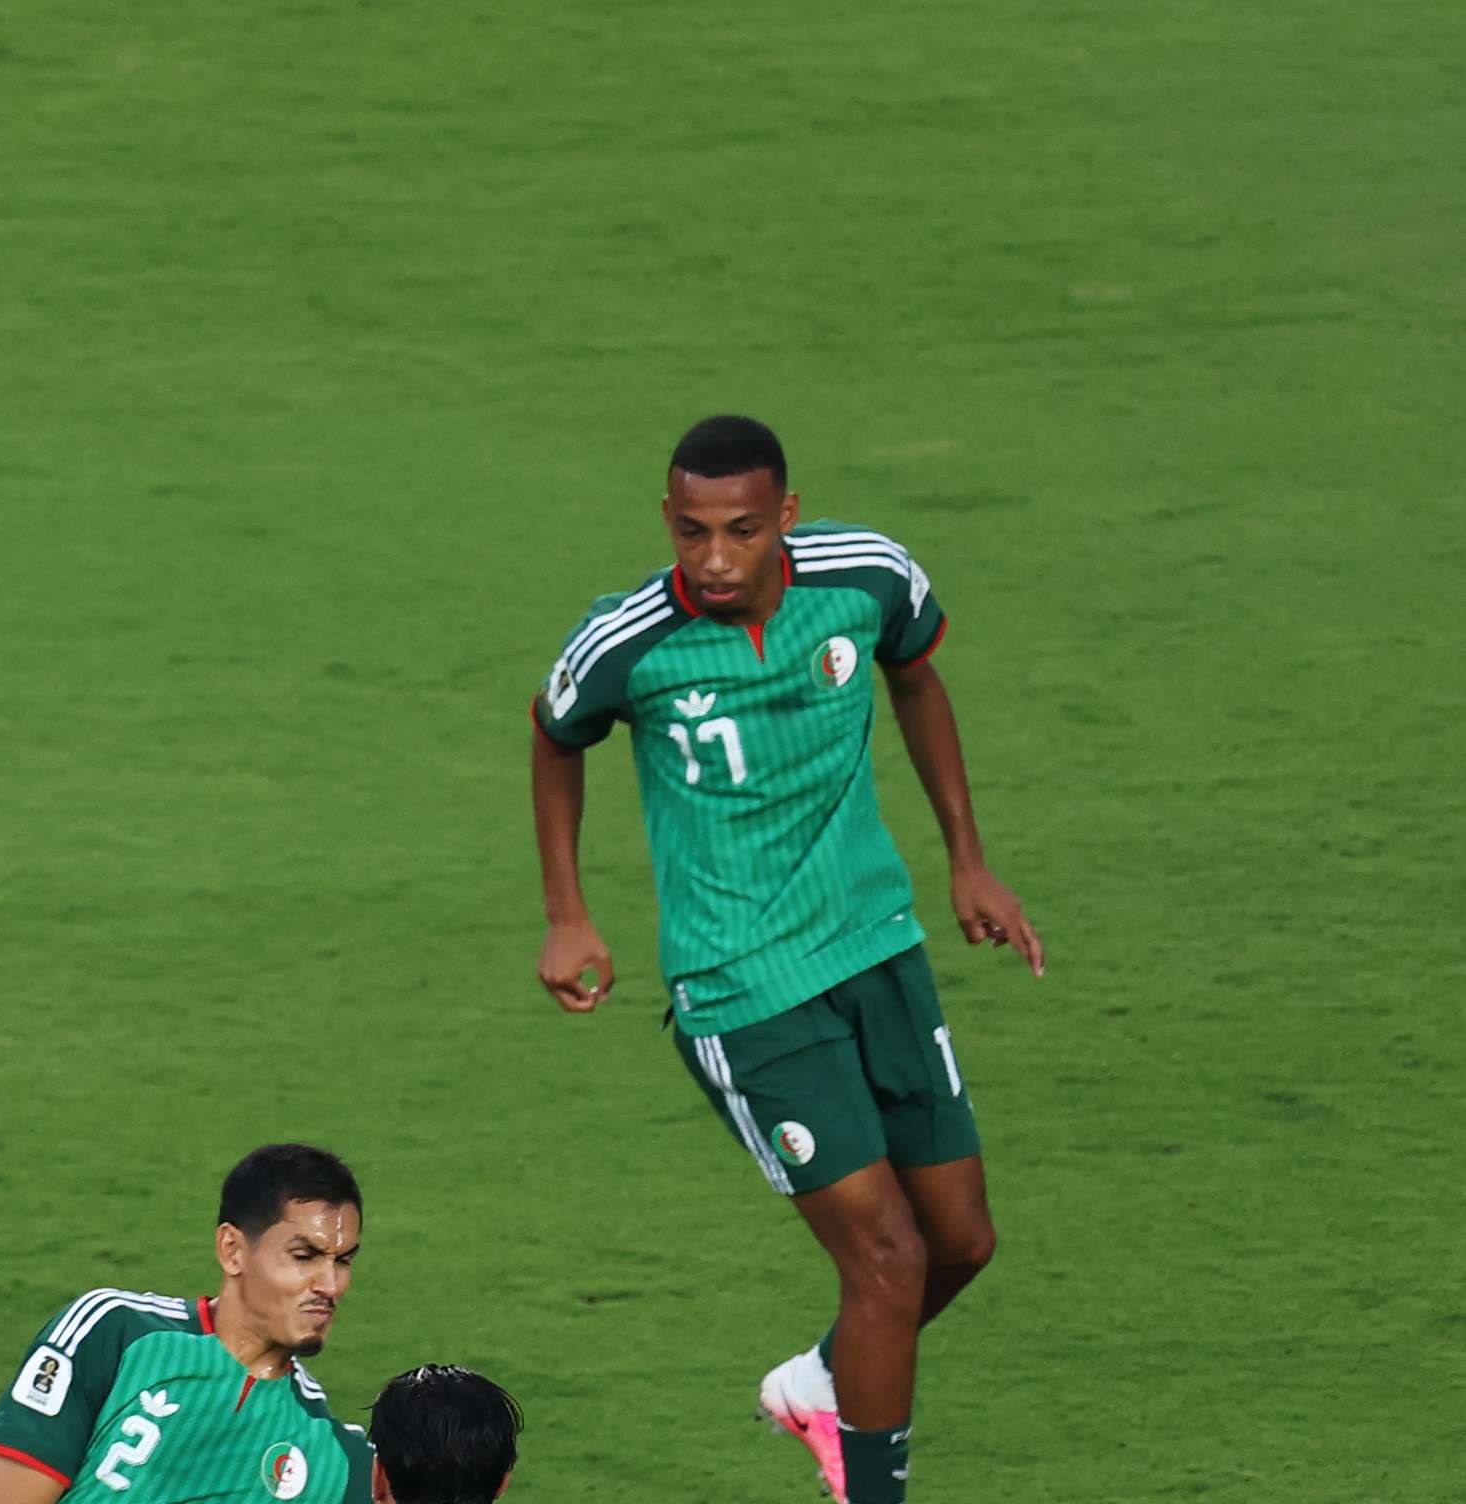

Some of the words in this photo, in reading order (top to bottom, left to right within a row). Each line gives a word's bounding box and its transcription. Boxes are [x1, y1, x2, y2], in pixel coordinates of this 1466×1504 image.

[668, 716, 748, 785] 17
[933, 1024, 961, 1097] 1
[95, 1414, 162, 1492] 2
